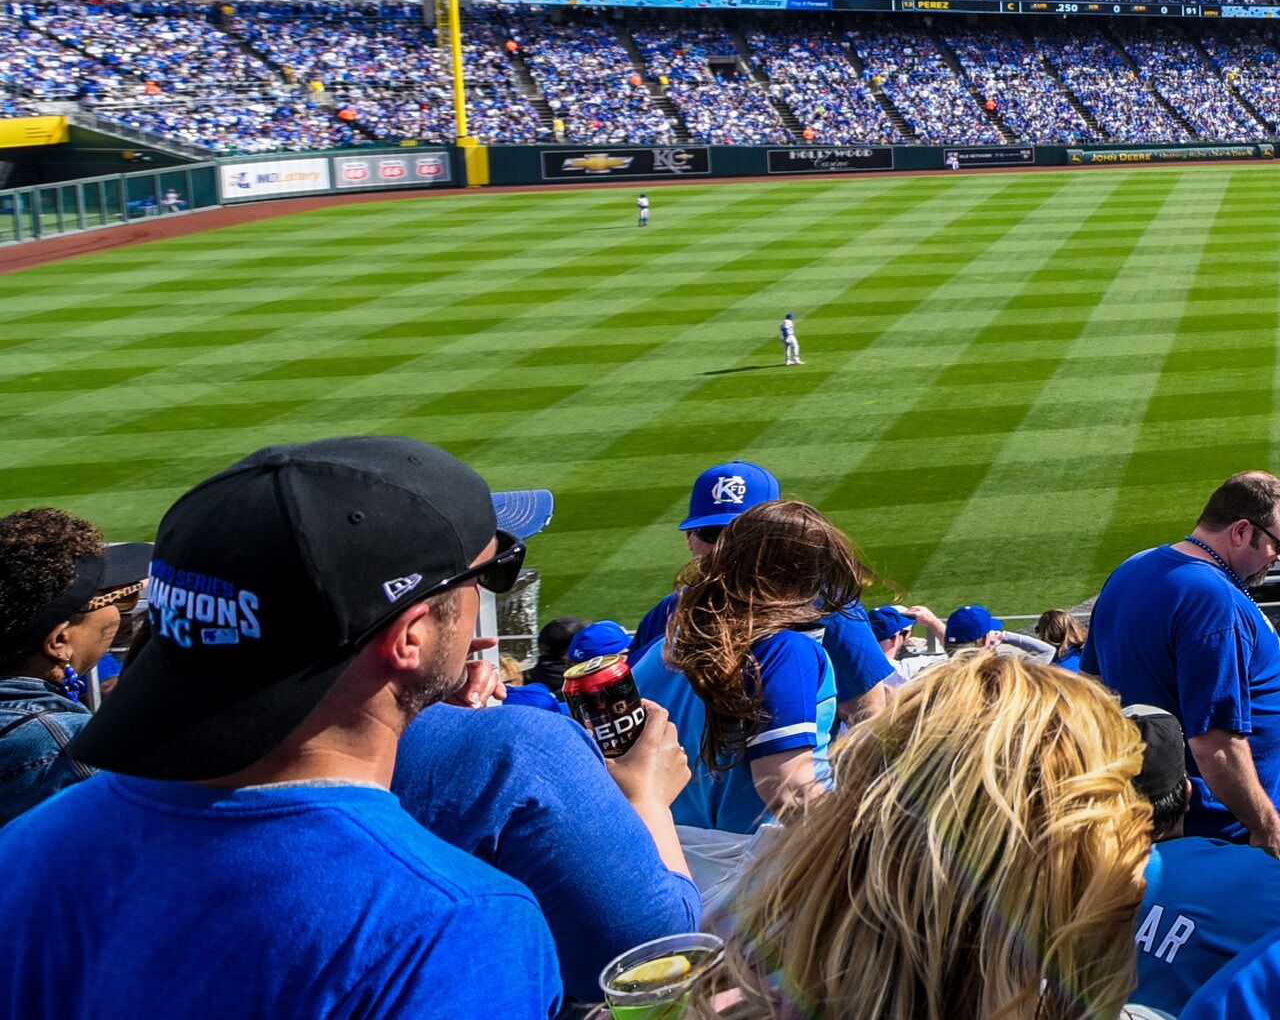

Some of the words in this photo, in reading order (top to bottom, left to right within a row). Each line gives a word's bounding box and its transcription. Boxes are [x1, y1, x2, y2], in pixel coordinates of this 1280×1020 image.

[917, 1, 949, 9] PEREZ
[1055, 3, 1078, 13] .250
[1113, 5, 1121, 13] 0
[1160, 6, 1168, 15] 0
[1186, 7, 1197, 15] 91
[788, 149, 874, 160] HOLLYWOOD
[1090, 153, 1117, 162] JOHN
[1119, 152, 1151, 162] DEERE
[813, 159, 849, 168] Casino
[423, 166, 436, 174] 66
[159, 604, 193, 649] KC
[595, 706, 646, 741] EDD
[602, 731, 634, 750] PPLE
[1134, 904, 1196, 964] AR
